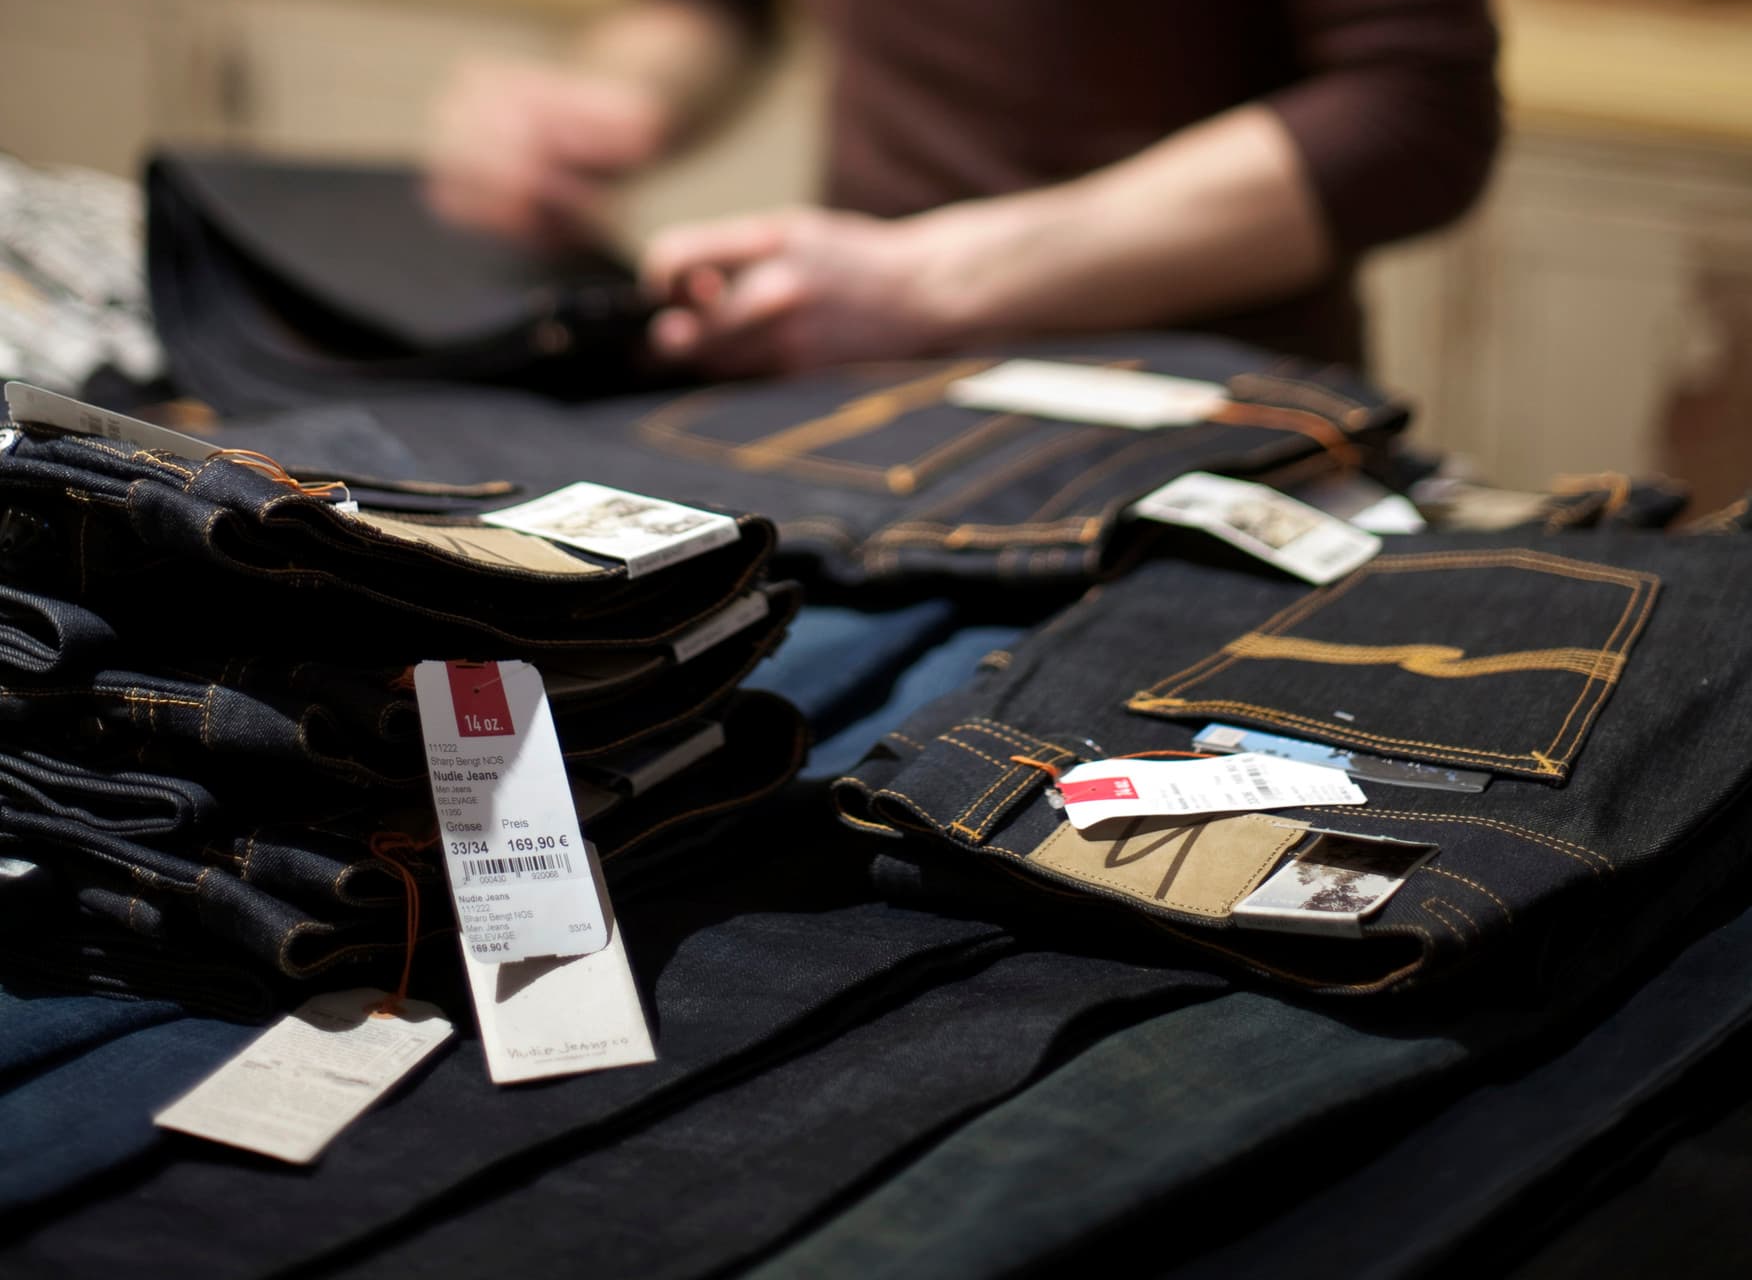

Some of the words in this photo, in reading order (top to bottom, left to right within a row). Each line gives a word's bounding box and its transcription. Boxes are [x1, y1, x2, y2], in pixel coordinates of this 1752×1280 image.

[464, 714, 482, 732] 14
[484, 718, 504, 732] oz.
[428, 743, 458, 753] 111222
[430, 756, 455, 767] Sharp
[433, 770, 464, 782] Nudie
[466, 770, 499, 781] Jeans
[501, 818, 530, 829] Preis
[450, 840, 489, 856] 33/34
[507, 835, 556, 853] 169,90
[559, 834, 570, 848] €
[458, 894, 484, 904] Nudie
[485, 893, 511, 902] Jeans
